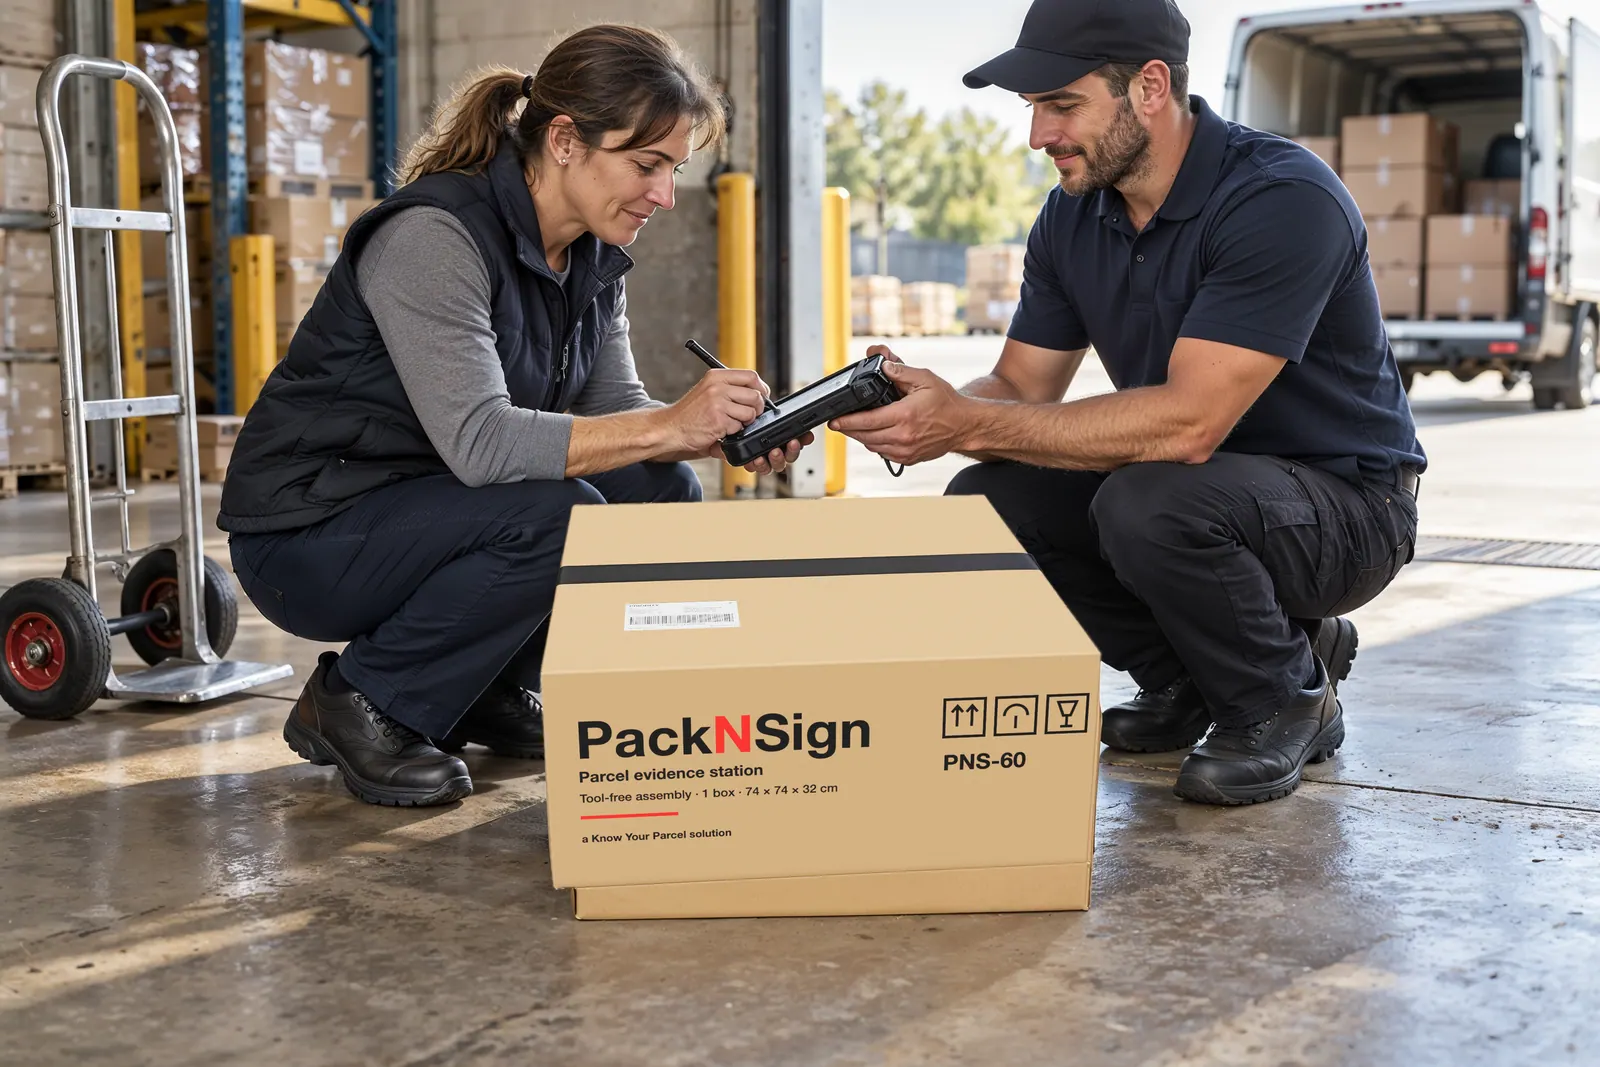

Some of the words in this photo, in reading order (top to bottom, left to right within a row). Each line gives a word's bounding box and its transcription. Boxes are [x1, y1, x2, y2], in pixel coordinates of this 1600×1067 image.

[577, 712, 871, 760] PackNSign
[943, 751, 1027, 772] PNS-60
[579, 768, 630, 784] Parcel
[633, 767, 705, 781] evidence
[709, 764, 764, 779] station
[580, 792, 633, 804] Tool-free
[635, 789, 692, 802] assembly
[702, 788, 708, 798] 1
[712, 788, 736, 798] box
[745, 786, 760, 797] 74
[773, 785, 789, 796] 74
[802, 784, 817, 794] 32
[820, 785, 838, 794] cm
[581, 836, 589, 844] a
[591, 834, 623, 843] Know
[625, 832, 651, 842] Your
[652, 830, 687, 841] Parcel
[689, 828, 732, 839] solution
